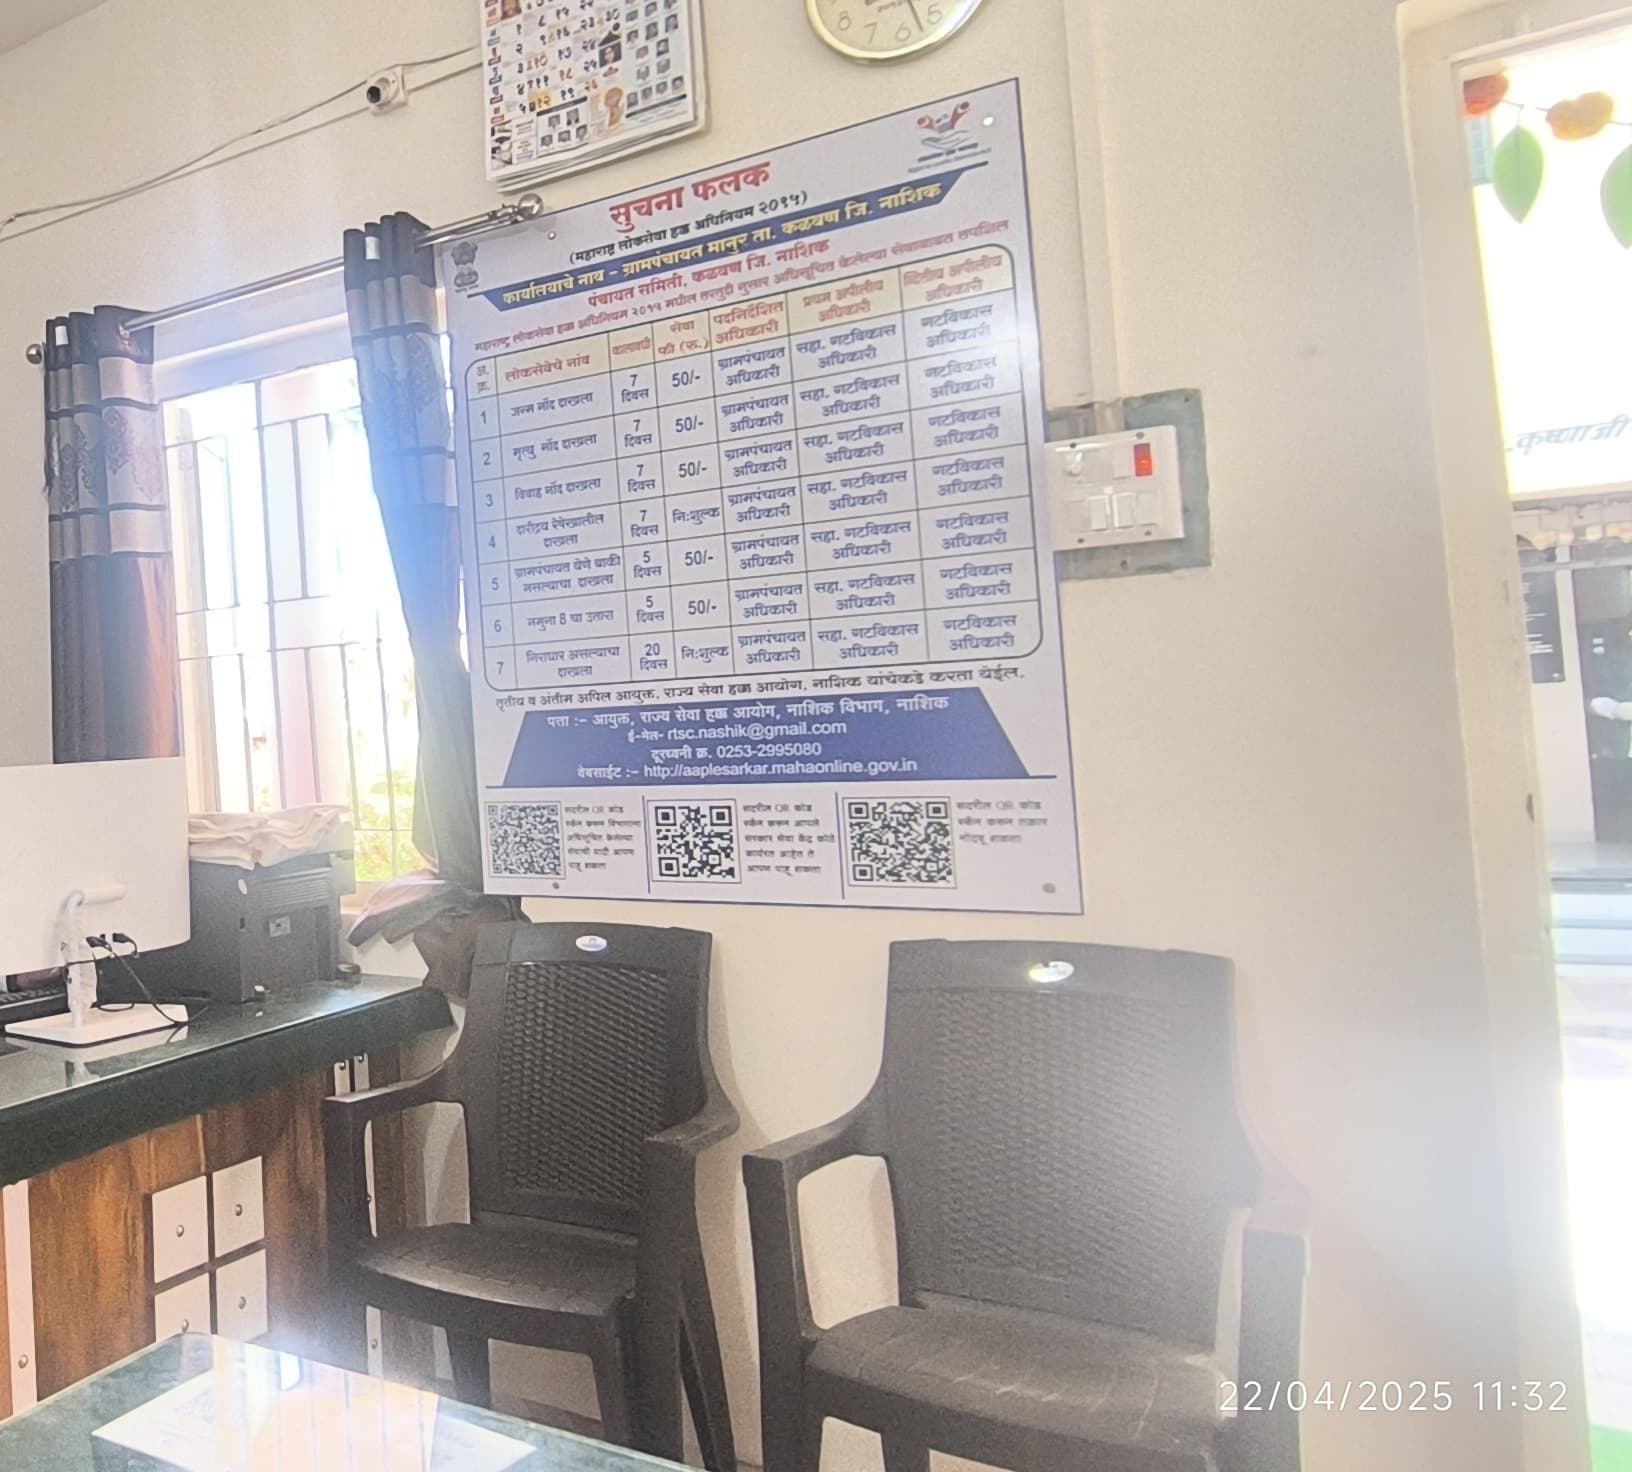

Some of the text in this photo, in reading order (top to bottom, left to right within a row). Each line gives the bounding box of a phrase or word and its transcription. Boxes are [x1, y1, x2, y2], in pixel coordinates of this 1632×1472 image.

[926, 4, 942, 25] 5
[837, 10, 912, 43] 8 7 6
[610, 161, 771, 233] सुचना फलक
[618, 226, 667, 251] लोकसेवा
[695, 205, 755, 230] अधिनियम
[758, 190, 808, 215] २०१५)
[502, 273, 574, 305] कार्यालयाचे
[578, 269, 606, 286] नाव
[622, 245, 704, 278] ग्रामपंचायत
[708, 232, 748, 256] मानुर
[752, 226, 776, 242] ता.
[782, 207, 840, 235] कळवण
[845, 199, 873, 220] जि.
[879, 182, 943, 210] नाशिक
[588, 239, 830, 308] पंचायत समिती. कळवण जि. नाशिक
[670, 320, 696, 334] सेवा
[920, 303, 994, 329] गटविकास
[715, 319, 780, 345] अधिकारी
[796, 323, 897, 355] सहा. गटविकास
[926, 323, 991, 349] अधिकारी
[718, 346, 786, 371] ग्रामपंचायत
[818, 346, 877, 370] अधिकारी
[630, 374, 638, 388] 7
[671, 369, 701, 388] 50/-
[726, 364, 781, 387] अधिकारी
[511, 404, 535, 417] जन्म
[558, 392, 594, 409] दाखला
[621, 388, 650, 404] दिवस
[480, 411, 488, 424] 1
[728, 485, 797, 507] ग्रामपंचायत
[639, 509, 647, 522] 7
[736, 504, 791, 523] अधिकारी
[488, 535, 497, 549] 4
[630, 524, 659, 538] दिवस
[646, 595, 654, 608] 5
[688, 598, 717, 616] 50/-
[493, 619, 502, 633] 6
[527, 615, 557, 632] नमुना
[585, 608, 614, 624] उतारा
[636, 610, 665, 624] दिवस
[528, 695, 537, 706] व
[577, 690, 612, 705] अपिल
[664, 684, 694, 699] राज्य
[698, 682, 725, 697] सेवा
[812, 673, 862, 691] नाशिक
[929, 669, 974, 684] करता
[979, 664, 1025, 682] येईल.
[546, 714, 570, 728] पत्ता
[639, 709, 671, 725] राज्य
[675, 706, 701, 721] सेवा
[786, 698, 835, 717] नाशिक
[839, 697, 891, 715] विभाग,
[896, 693, 951, 712] नाशिक
[667, 722, 847, 742] rtsc.nashik@gmail.com
[716, 742, 822, 759] 0253-2995080
[643, 758, 918, 780] http://aaplesarkar.mahaonline.gov.in
